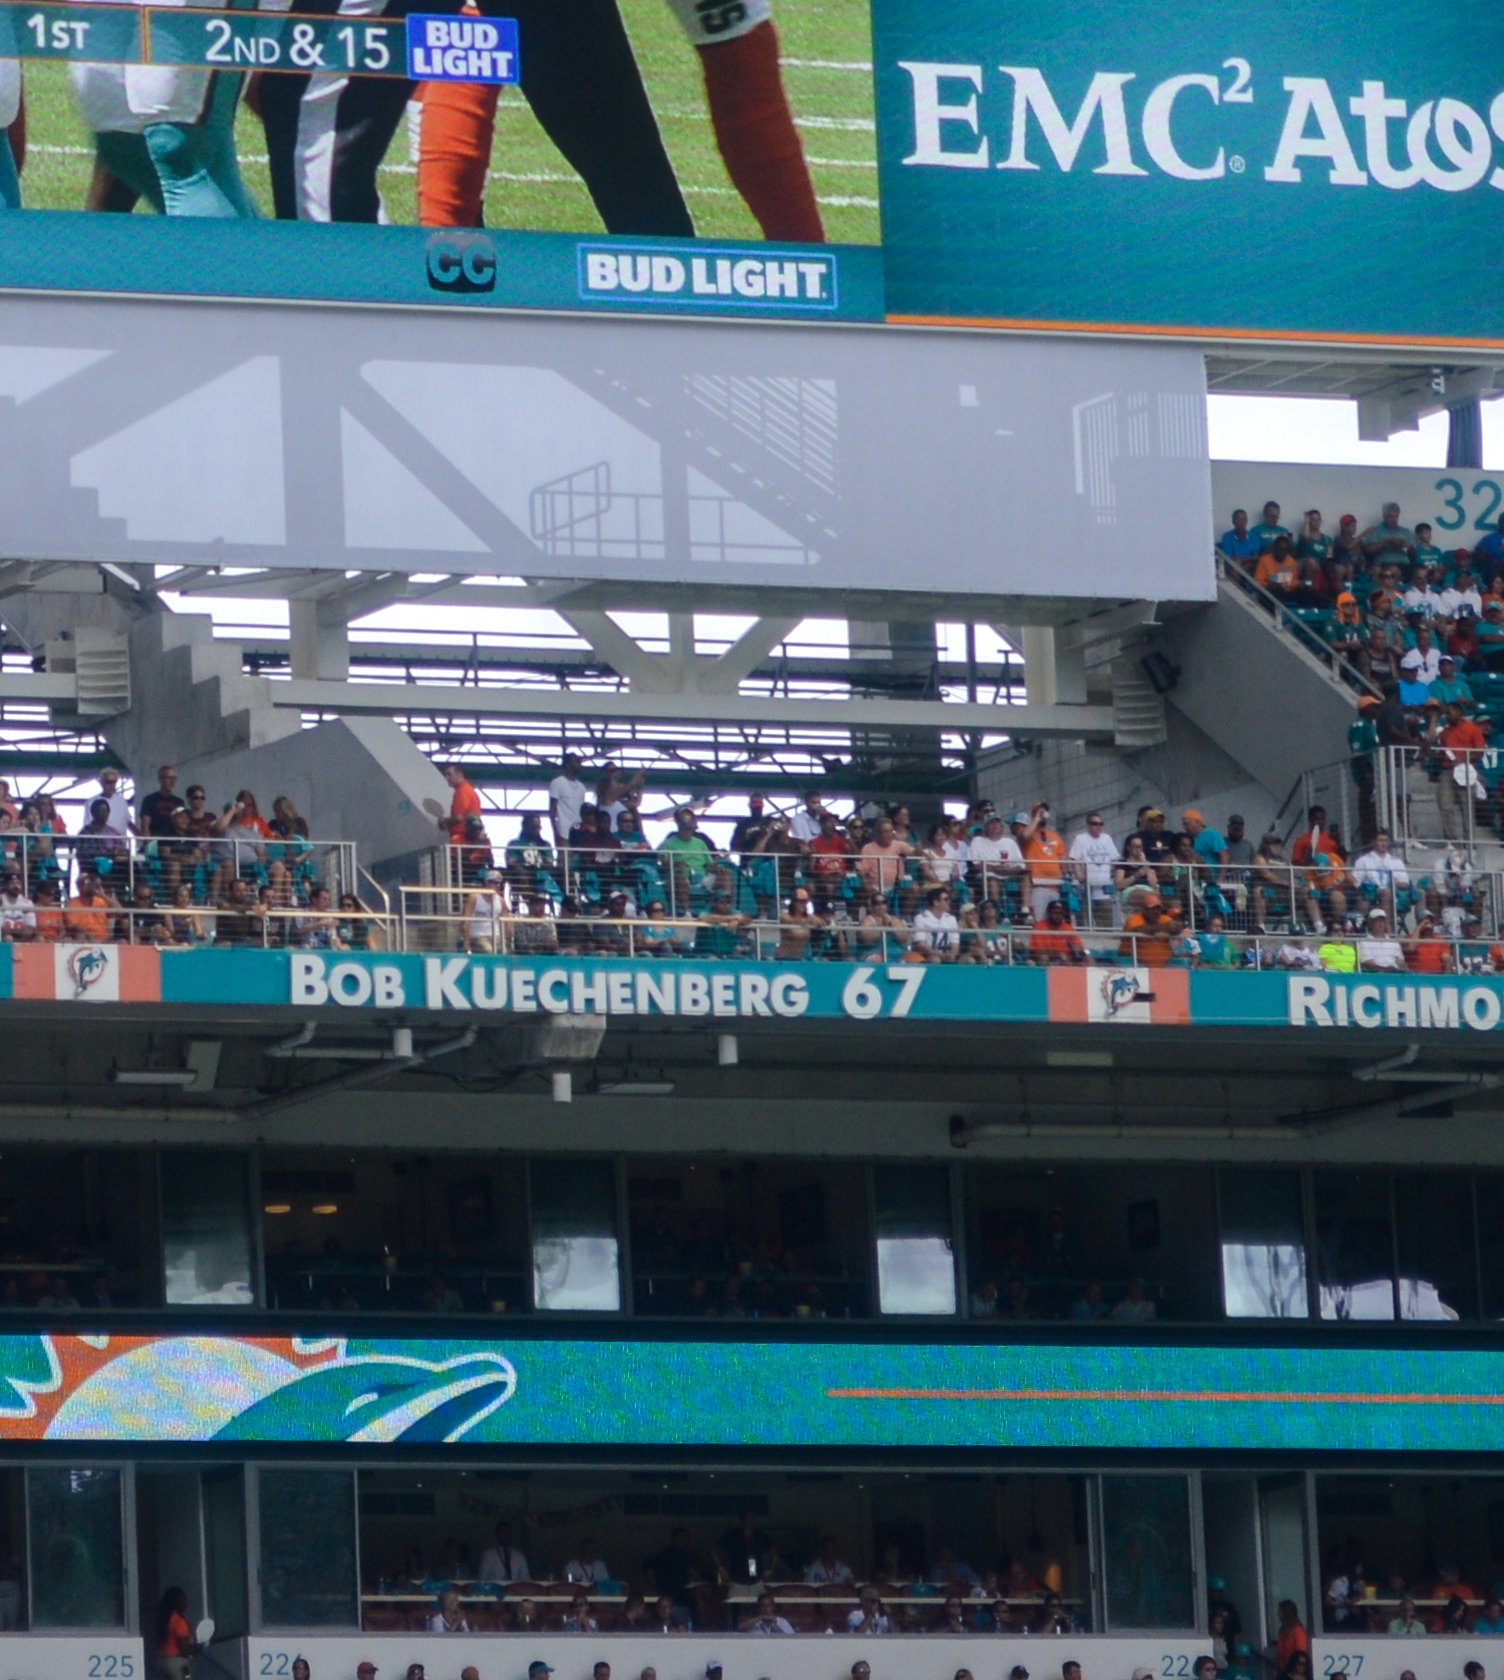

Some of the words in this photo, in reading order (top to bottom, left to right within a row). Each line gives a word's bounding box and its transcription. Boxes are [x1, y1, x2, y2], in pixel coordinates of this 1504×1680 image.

[27, 13, 90, 52] 1ST
[205, 20, 280, 65] 2ND
[289, 24, 325, 67] &
[336, 26, 390, 70] 15
[426, 21, 498, 50] BUD
[412, 46, 513, 78] LIGHT
[427, 237, 496, 285] CC
[587, 251, 685, 293] BUD
[692, 256, 829, 300] LIGHT
[289, 952, 405, 1009] BOB
[425, 957, 810, 1018] KUECHENBERG
[842, 965, 926, 1020] 67
[87, 1655, 134, 1679] 225
